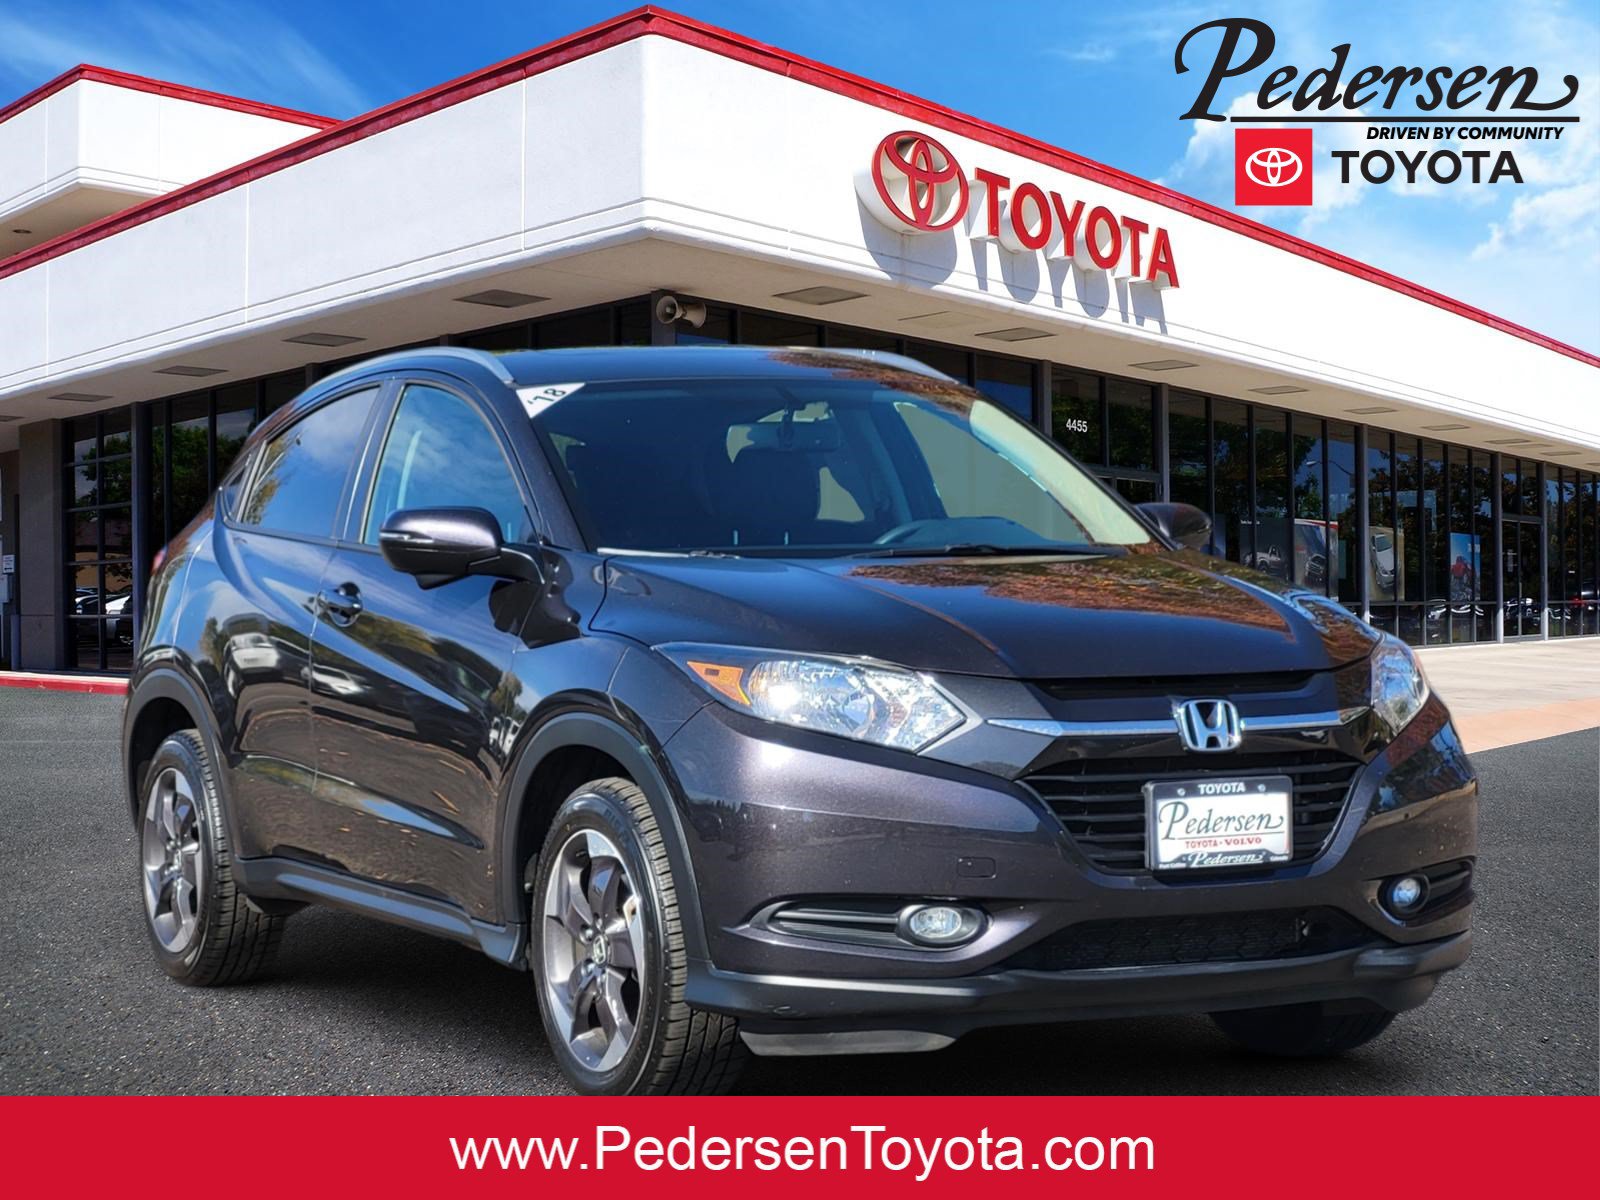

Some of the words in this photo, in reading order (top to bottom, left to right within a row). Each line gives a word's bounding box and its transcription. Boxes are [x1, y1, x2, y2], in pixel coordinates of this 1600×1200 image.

[974, 166, 1180, 289] TOYOTA
[1065, 418, 1088, 433] 4455
[1197, 781, 1247, 795] TOYOTA
[1158, 800, 1285, 841] Pedersen
[1187, 851, 1264, 868] Pedersen
